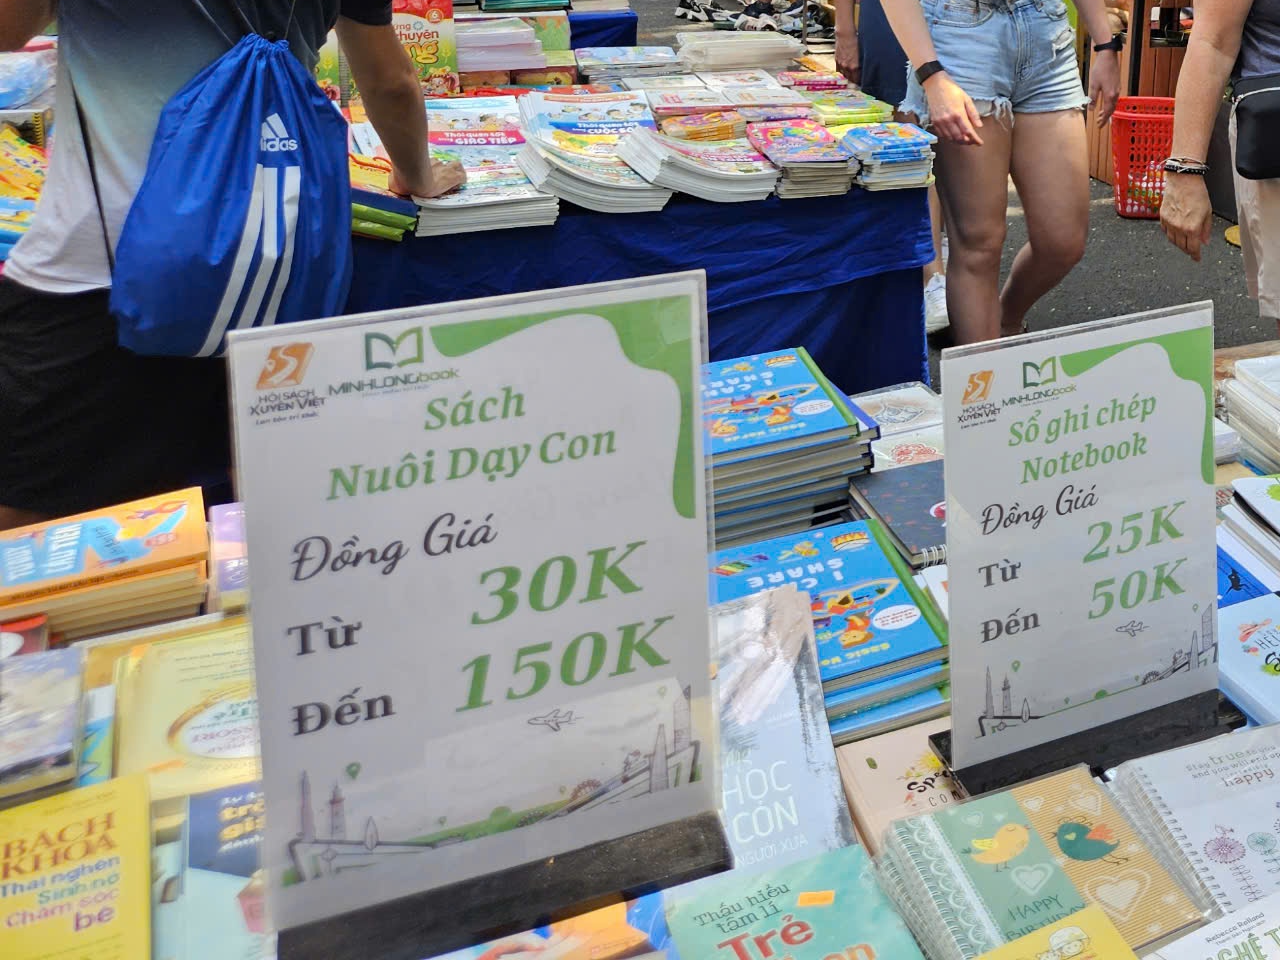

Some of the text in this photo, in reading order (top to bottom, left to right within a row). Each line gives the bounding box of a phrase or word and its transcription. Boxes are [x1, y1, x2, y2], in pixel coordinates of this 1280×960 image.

[423, 385, 527, 431] Sách
[1008, 393, 1158, 447] Sổ ghi chép
[325, 428, 618, 501] Nuôi Dạy Con
[1020, 432, 1149, 486] Notebook
[980, 484, 1101, 536] Đồng Giá
[1082, 500, 1187, 564] 25K
[292, 512, 499, 583] Đồng Giá
[470, 540, 648, 627] 30K
[977, 558, 1023, 588] Từ
[1087, 557, 1189, 621] 50K
[287, 615, 363, 657] Từ
[980, 609, 1042, 644] Đến
[454, 615, 676, 713] 150K
[292, 687, 397, 737] Đến
[1208, 750, 1245, 765] true
[1220, 767, 1275, 787] happy
[692, 882, 791, 927] Thấu hiểu
[716, 908, 761, 935] tâm
[1007, 893, 1064, 922] HAPPY
[1205, 924, 1239, 944] Rebecca
[1237, 911, 1265, 927] Rolland
[717, 913, 816, 960] Trẻ
